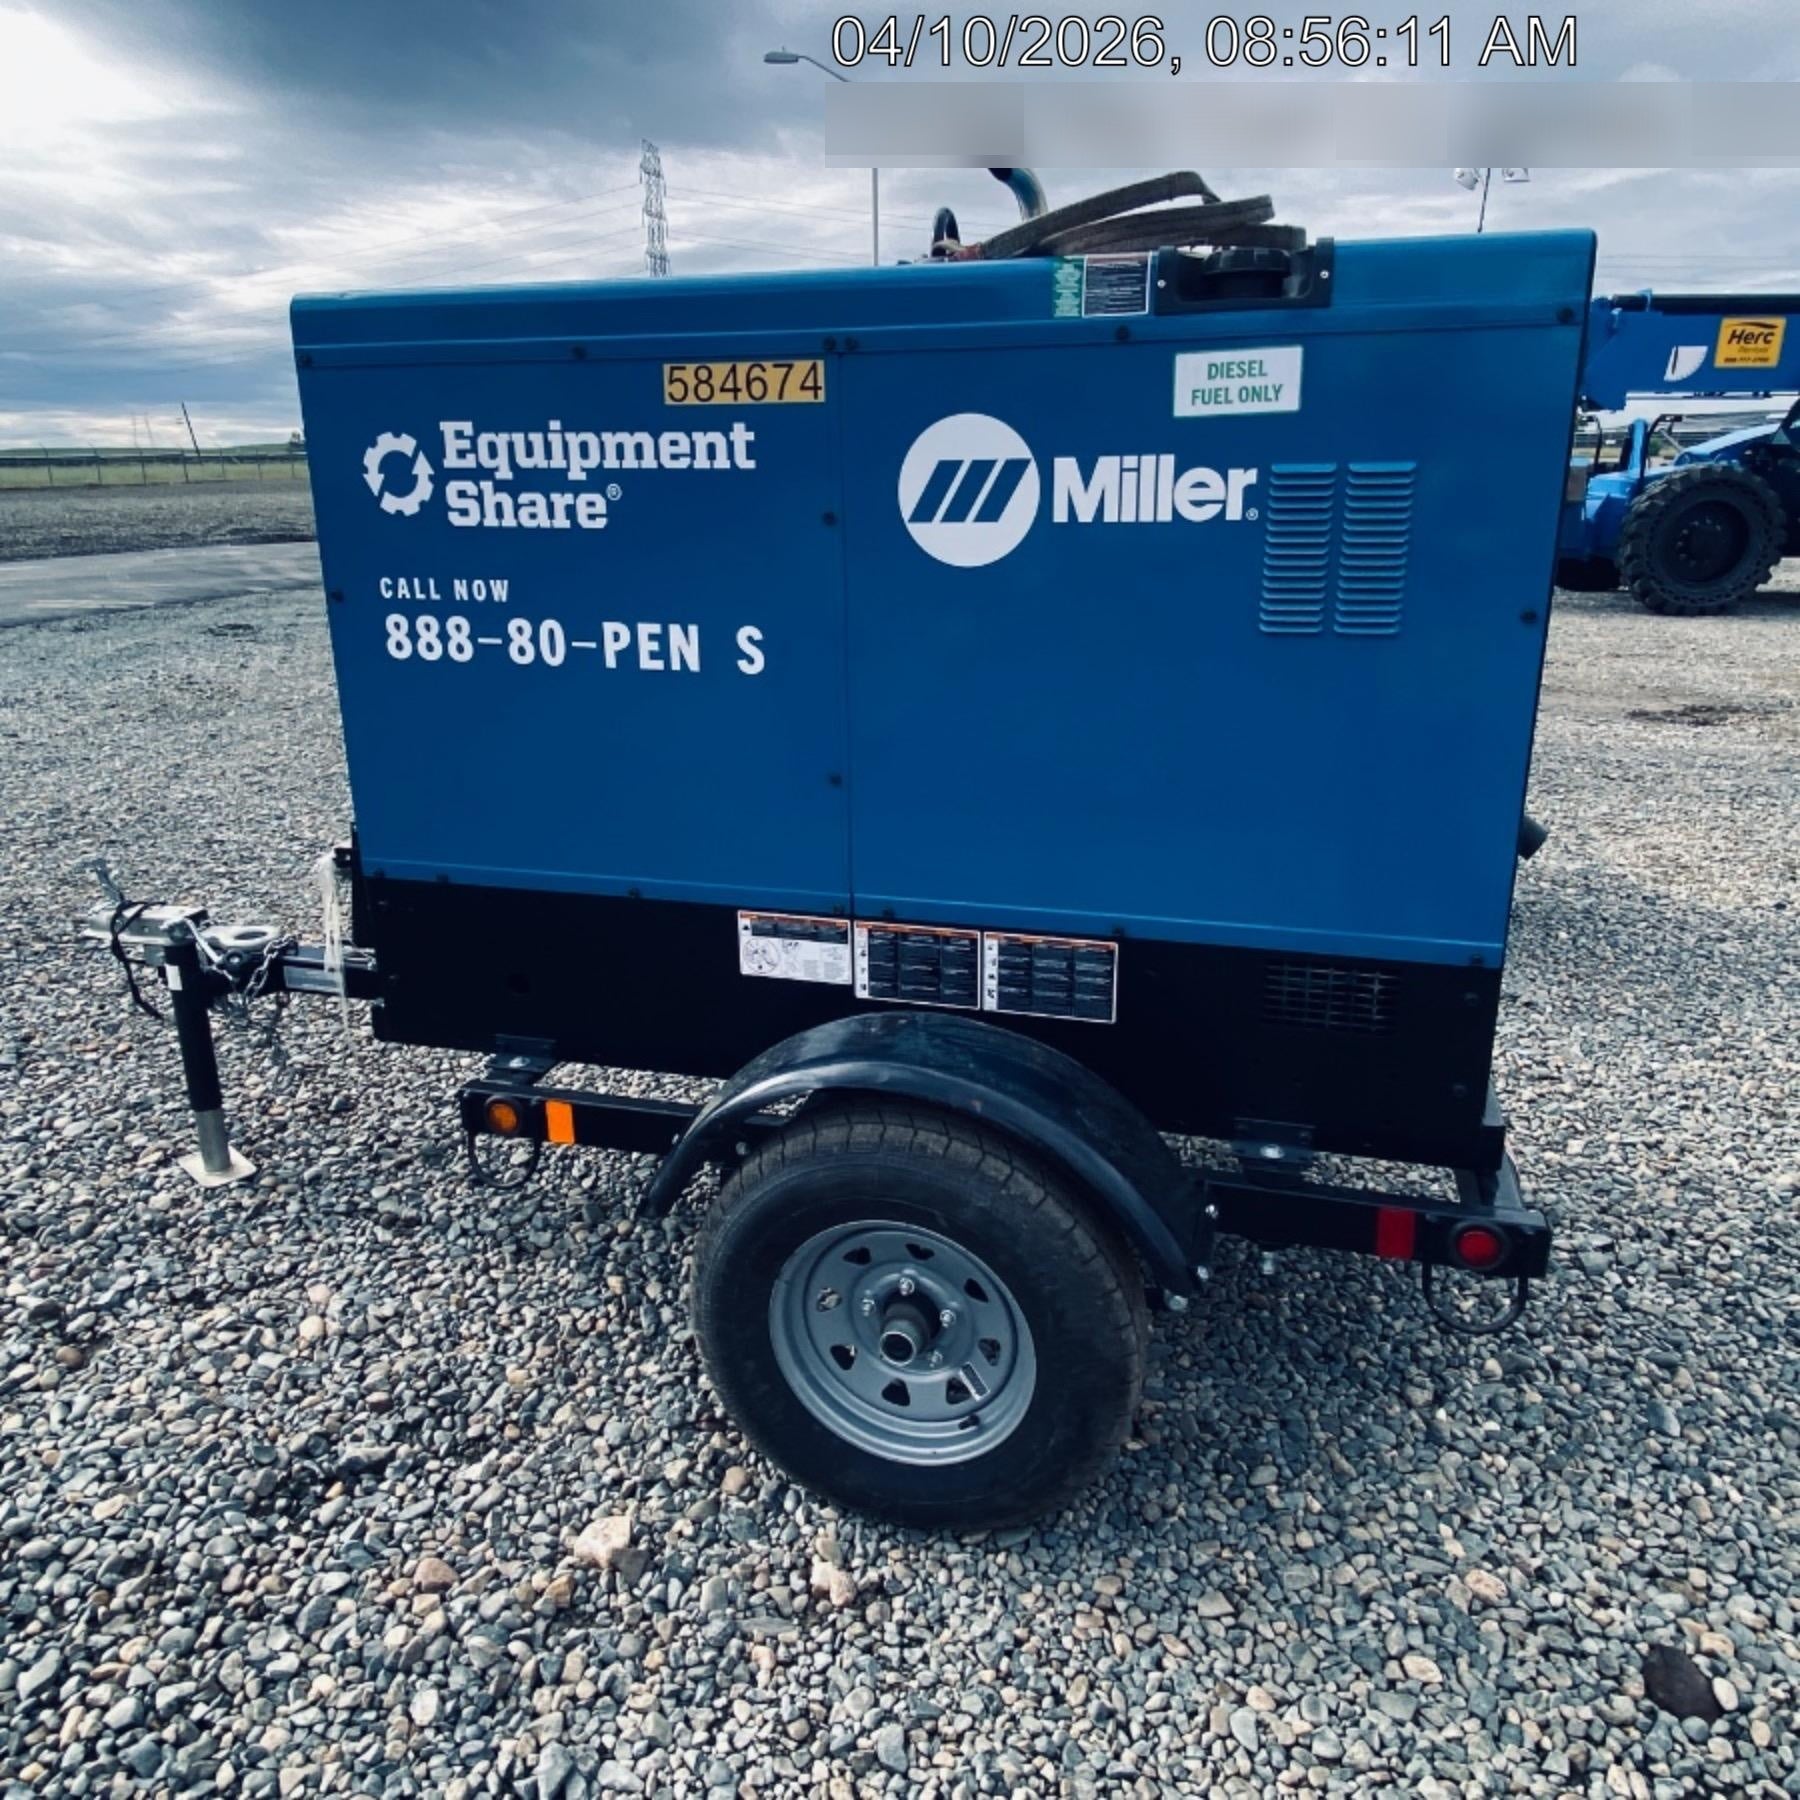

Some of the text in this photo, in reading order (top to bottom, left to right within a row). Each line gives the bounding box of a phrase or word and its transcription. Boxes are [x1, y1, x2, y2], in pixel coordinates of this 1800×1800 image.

[1727, 329, 1775, 345] Herc
[1207, 359, 1267, 380] DIESEL
[667, 362, 823, 403] 584674
[1191, 385, 1283, 406] FUEL ONLY
[438, 420, 757, 481] Equipment
[379, 576, 509, 603] CALL NOW
